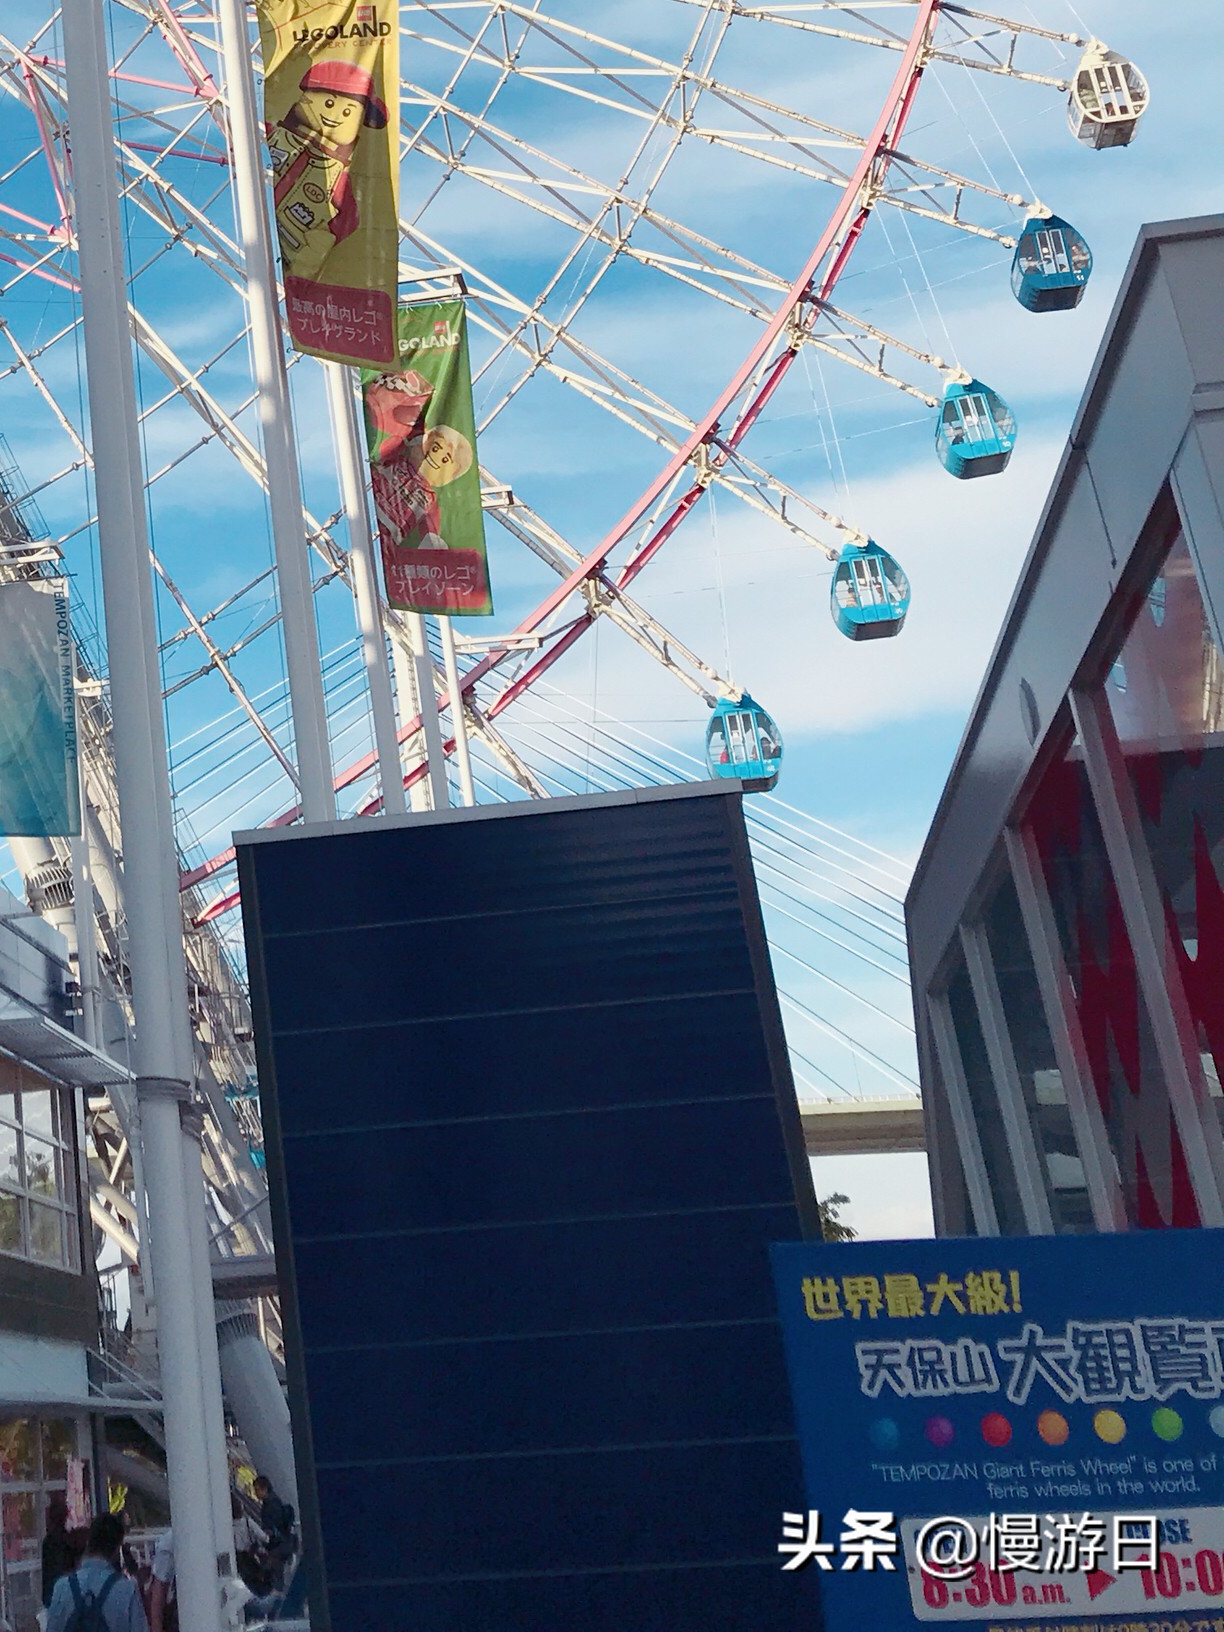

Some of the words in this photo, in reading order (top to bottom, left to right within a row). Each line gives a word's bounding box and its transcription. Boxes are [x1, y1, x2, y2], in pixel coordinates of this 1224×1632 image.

[292, 5, 392, 42] LEGOLAND
[398, 320, 461, 351] GOLAND
[53, 585, 70, 658] TEMPOZAN
[802, 1270, 1023, 1320] 世界最大級!
[856, 1318, 1224, 1405] 天保山大観覧
[983, 1462, 1026, 1479] Giant
[1030, 1459, 1076, 1477] Ferris
[1144, 1457, 1157, 1473] is
[1163, 1460, 1194, 1472] one
[1200, 1454, 1217, 1471] of
[987, 1481, 1029, 1499] ferris
[1034, 1479, 1092, 1497] wheels
[1096, 1477, 1112, 1495] in
[1117, 1477, 1145, 1494] the
[1150, 1475, 1200, 1493] world.
[1022, 1582, 1072, 1605] a.m.
[1135, 1548, 1224, 1600] 10:0
